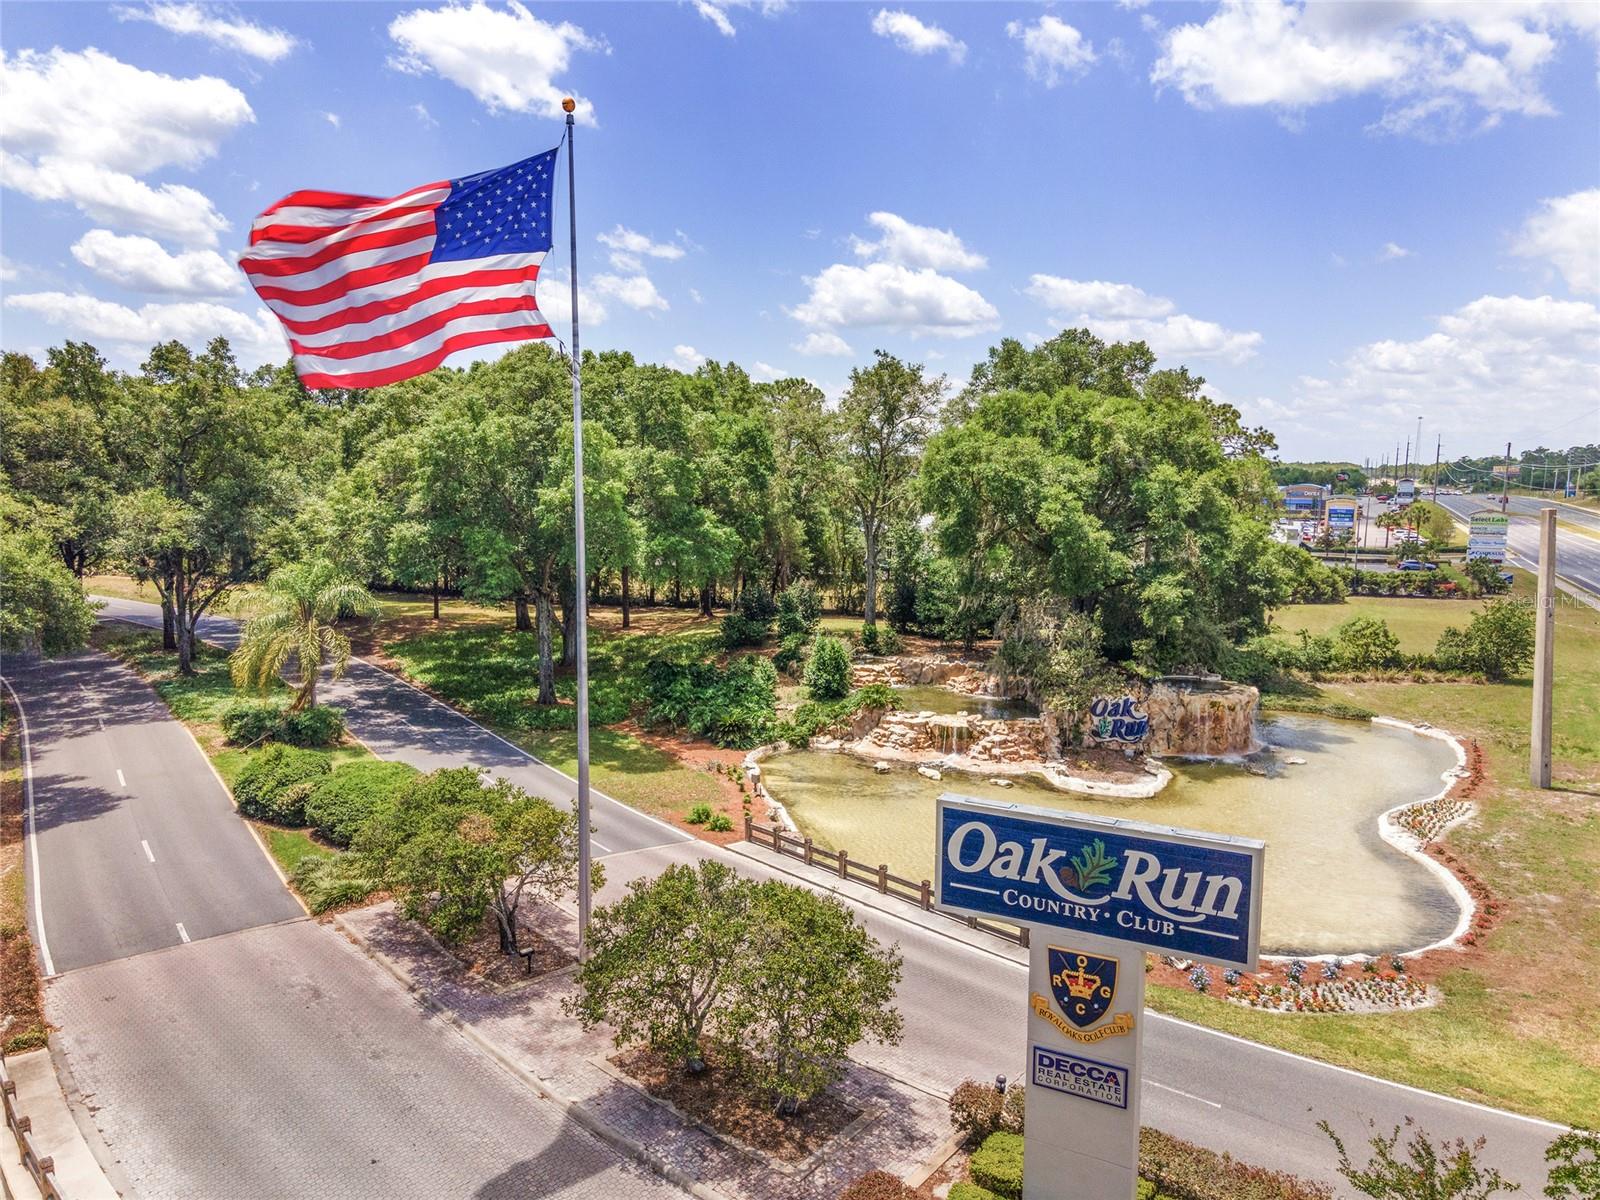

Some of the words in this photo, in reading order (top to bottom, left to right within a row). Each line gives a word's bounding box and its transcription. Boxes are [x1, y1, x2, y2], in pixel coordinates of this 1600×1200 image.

[1090, 697, 1147, 720] Oak
[1109, 718, 1149, 741] Run
[948, 821, 1110, 905] Oak
[1111, 849, 1243, 922] Run
[1003, 889, 1100, 922] COUNTRY
[1116, 910, 1175, 936] CLUB
[1039, 1008, 1062, 1027] ROYAL
[1061, 1026, 1083, 1041] OAKS
[1083, 1028, 1104, 1042] GOLF
[1103, 1024, 1126, 1035] CLUB
[1038, 1053, 1121, 1087] DECCA
[1038, 1067, 1070, 1082] REAL
[1074, 1076, 1121, 1095] ESTATE
[1037, 1075, 1122, 1103] CORPORATION
